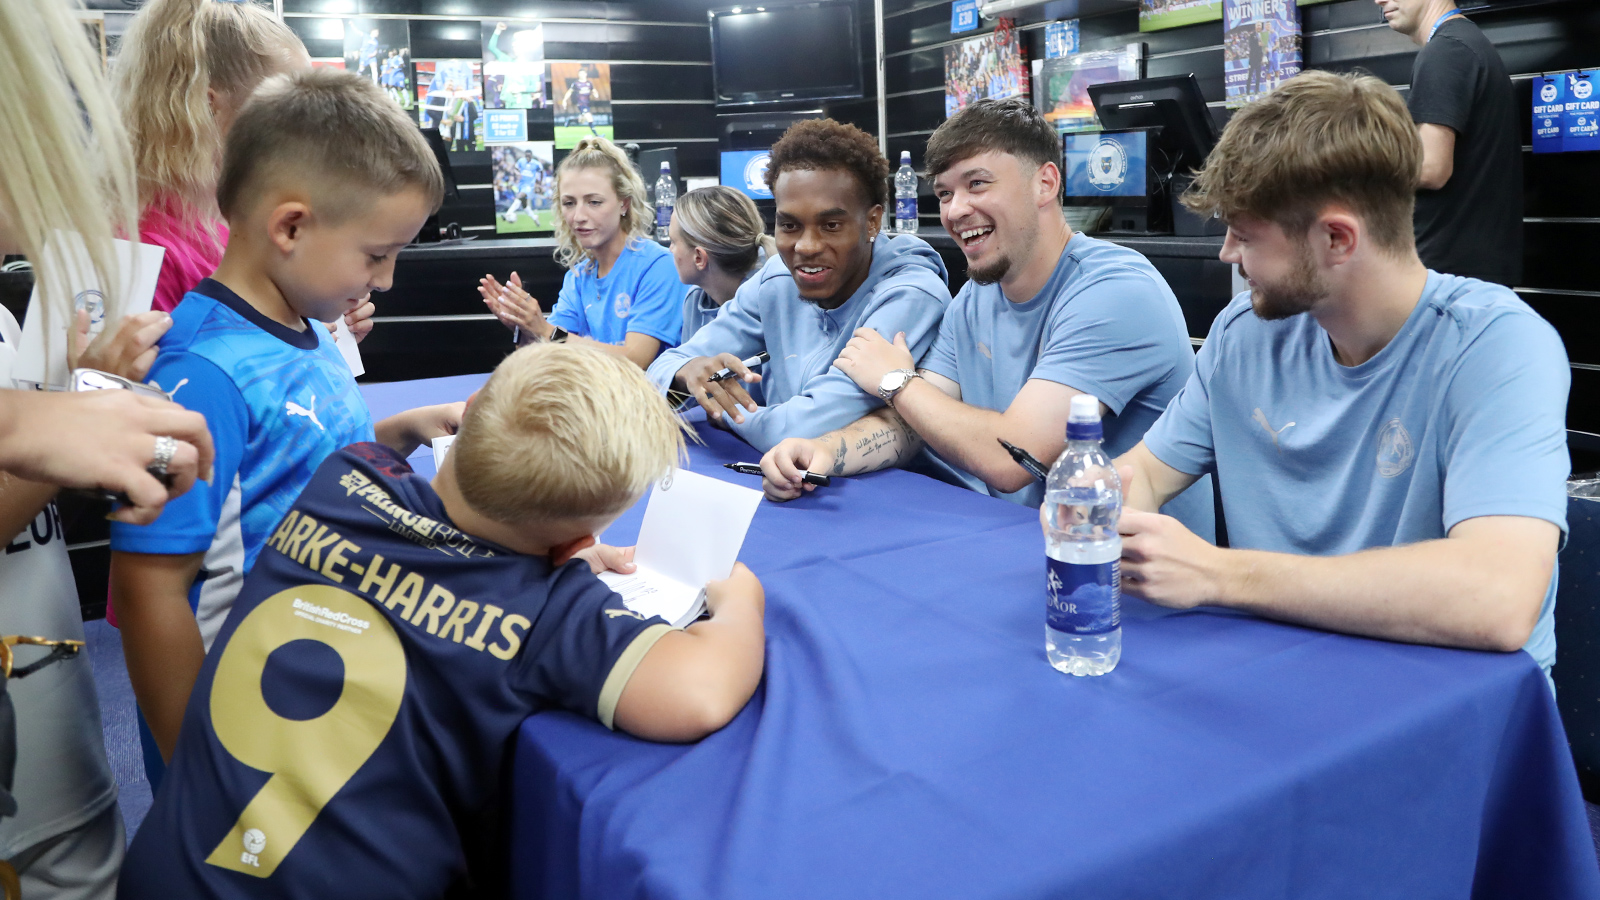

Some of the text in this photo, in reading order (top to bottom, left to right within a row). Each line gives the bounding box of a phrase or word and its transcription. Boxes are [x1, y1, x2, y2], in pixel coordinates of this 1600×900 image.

[1229, 0, 1287, 21] WINNERS
[1533, 104, 1564, 114] GIFT CARD
[1565, 101, 1600, 111] GIFT CARD
[388, 519, 438, 550] LIMITED
[266, 510, 532, 661] ARKE-HARRIS
[205, 584, 407, 879] 9
[240, 851, 260, 868] EFL
